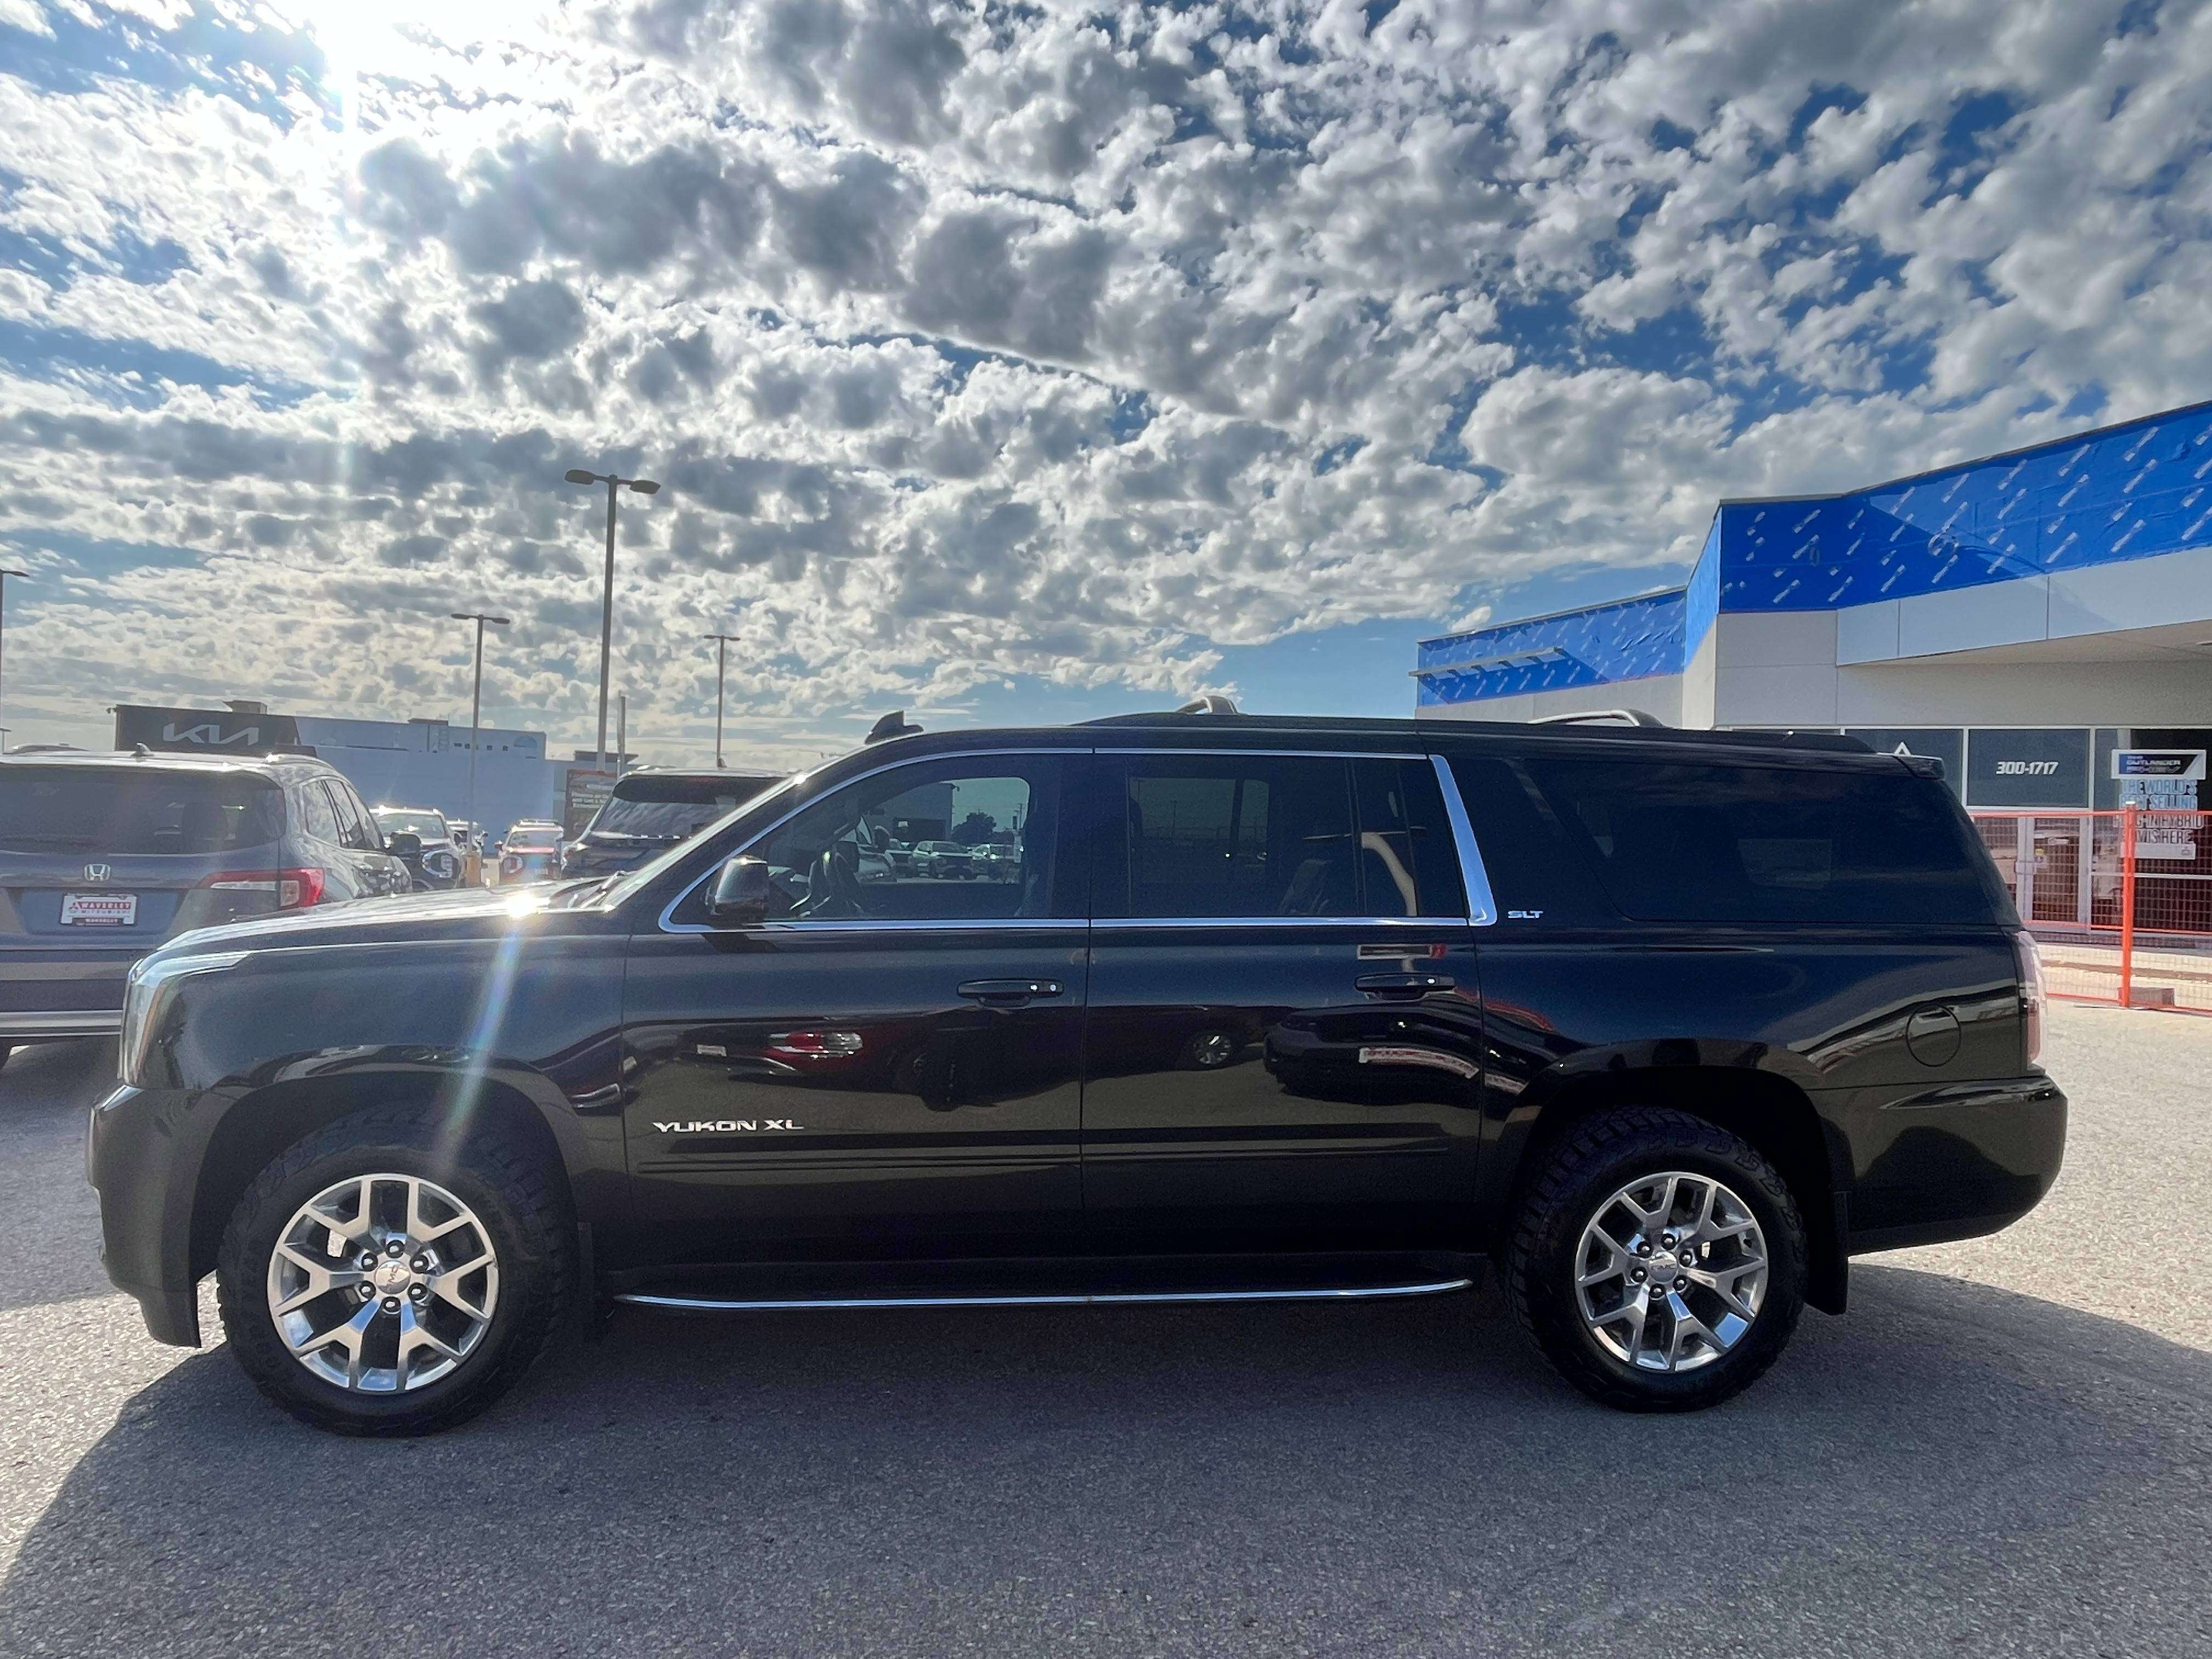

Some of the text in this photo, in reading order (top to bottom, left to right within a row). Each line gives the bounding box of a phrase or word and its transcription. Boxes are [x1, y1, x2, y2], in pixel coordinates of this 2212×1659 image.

[163, 723, 259, 746] KIA
[1996, 761, 2059, 775] 300-1717
[2162, 829, 2194, 844] HERE
[652, 1119, 804, 1132] YUKON XL
